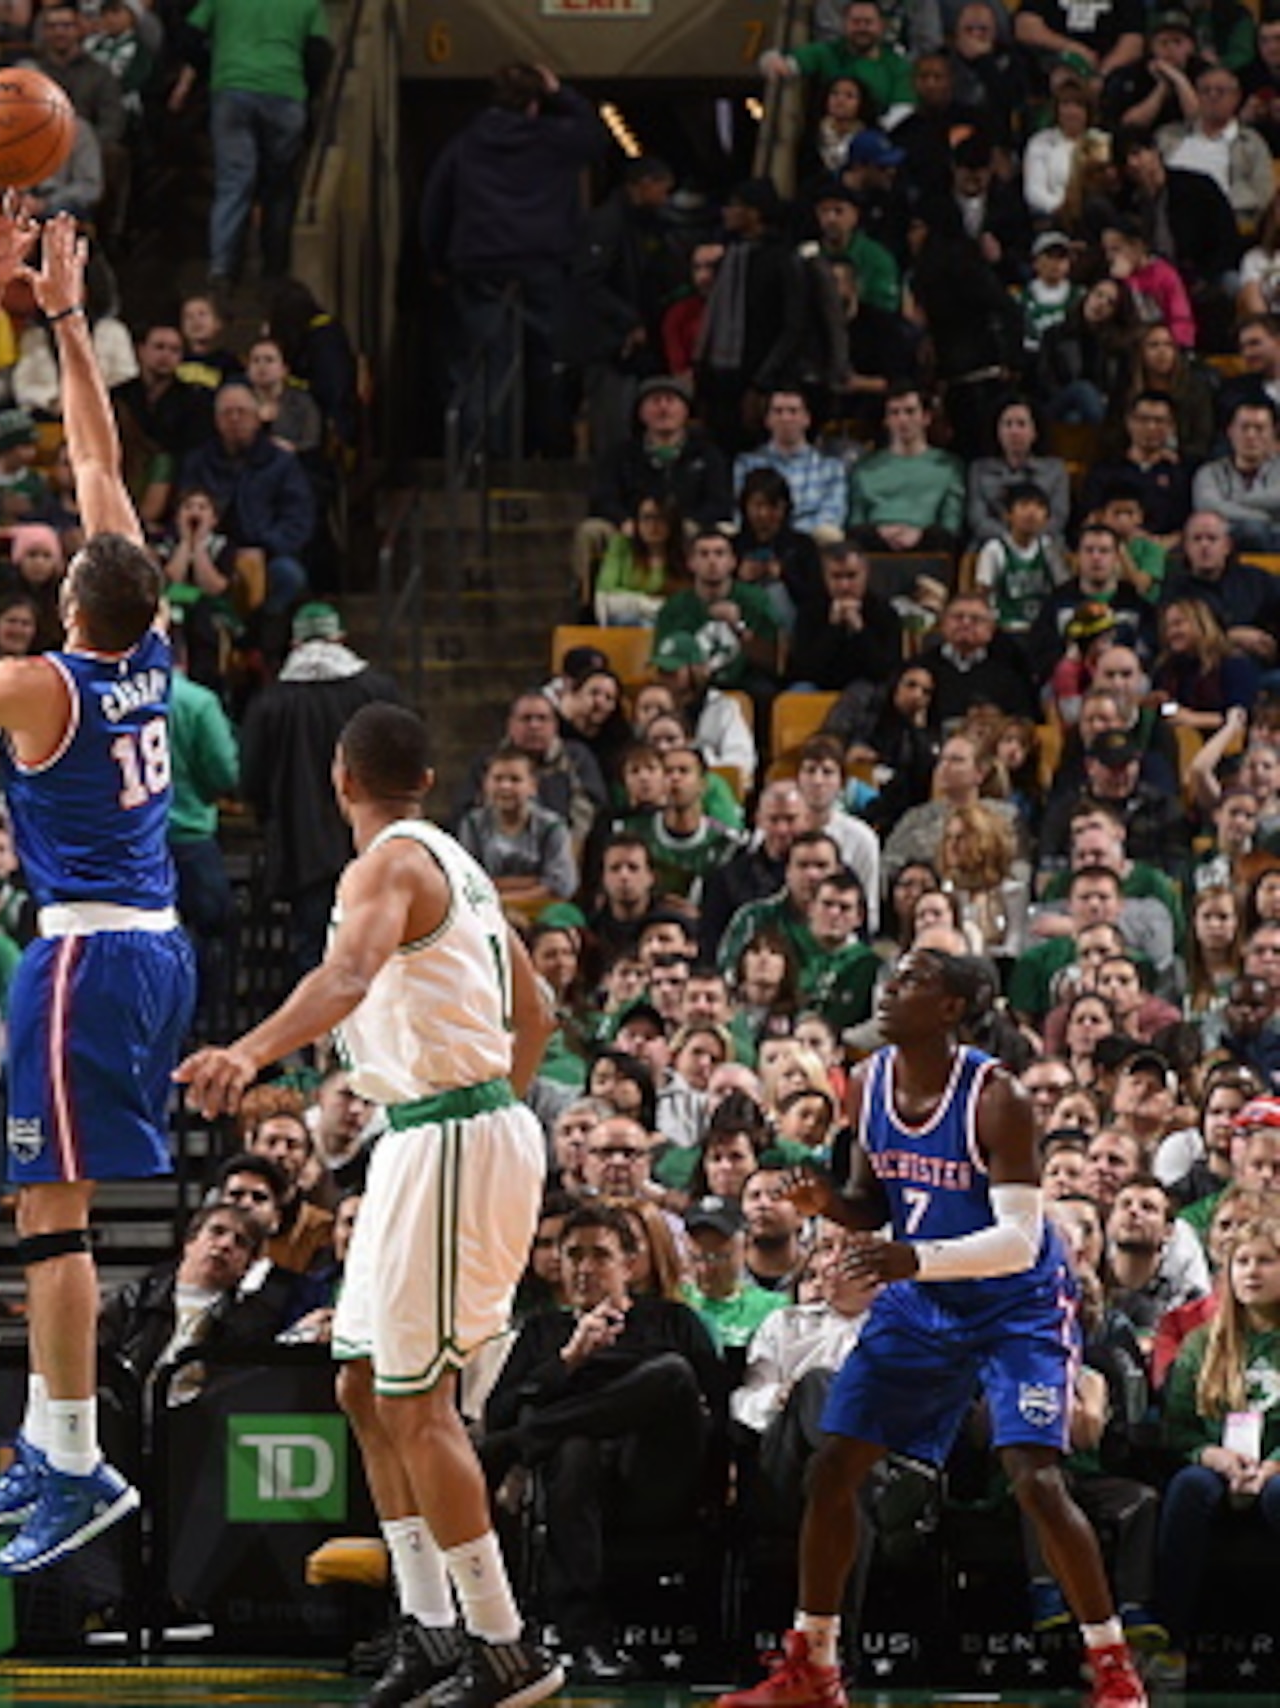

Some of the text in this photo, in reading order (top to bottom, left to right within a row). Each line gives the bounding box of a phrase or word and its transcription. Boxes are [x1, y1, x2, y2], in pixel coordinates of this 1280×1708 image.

[428, 20, 452, 63] 6
[741, 20, 765, 61] 7
[109, 715, 170, 811] 18
[902, 1188, 931, 1235] 7
[237, 1433, 336, 1500] TD
